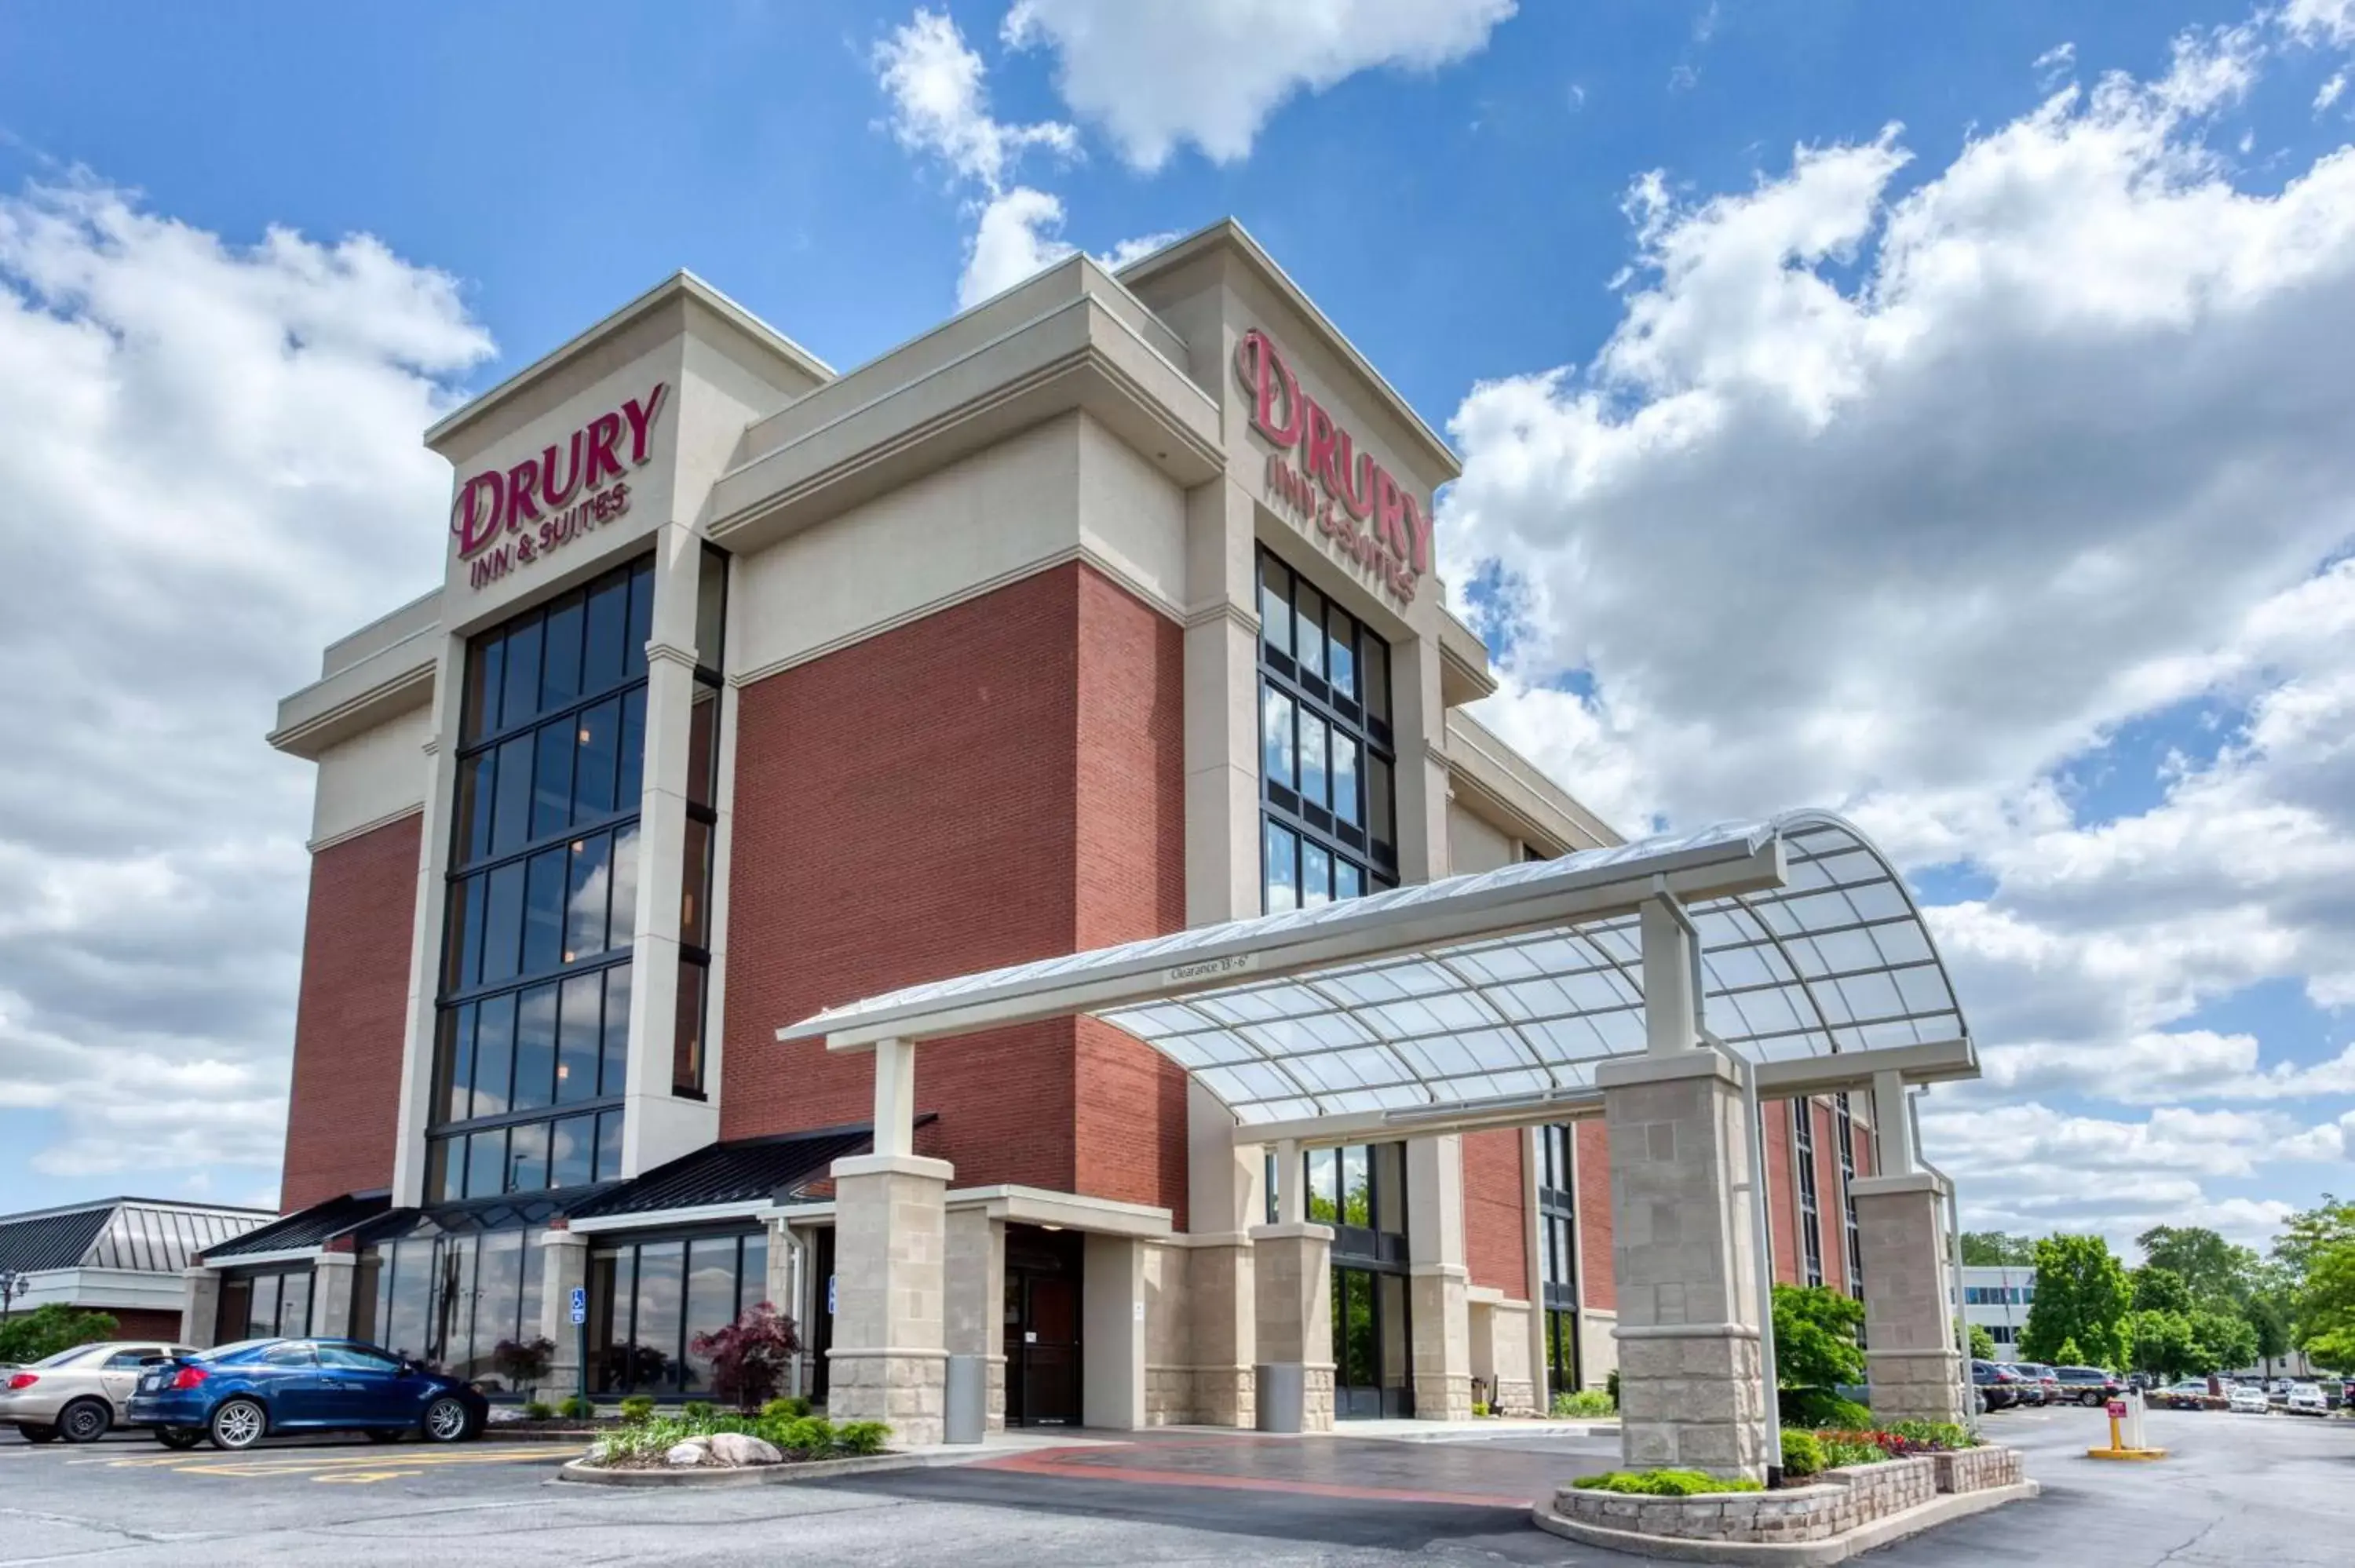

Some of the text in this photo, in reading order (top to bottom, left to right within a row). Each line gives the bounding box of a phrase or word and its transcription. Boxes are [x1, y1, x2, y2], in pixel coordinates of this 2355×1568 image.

[451, 381, 666, 560] DRURY
[1236, 328, 1433, 574] DRURY
[470, 482, 630, 589] INN & SUITES
[1267, 454, 1415, 605] INN & SUITES
[1171, 962, 1218, 979] Clearance
